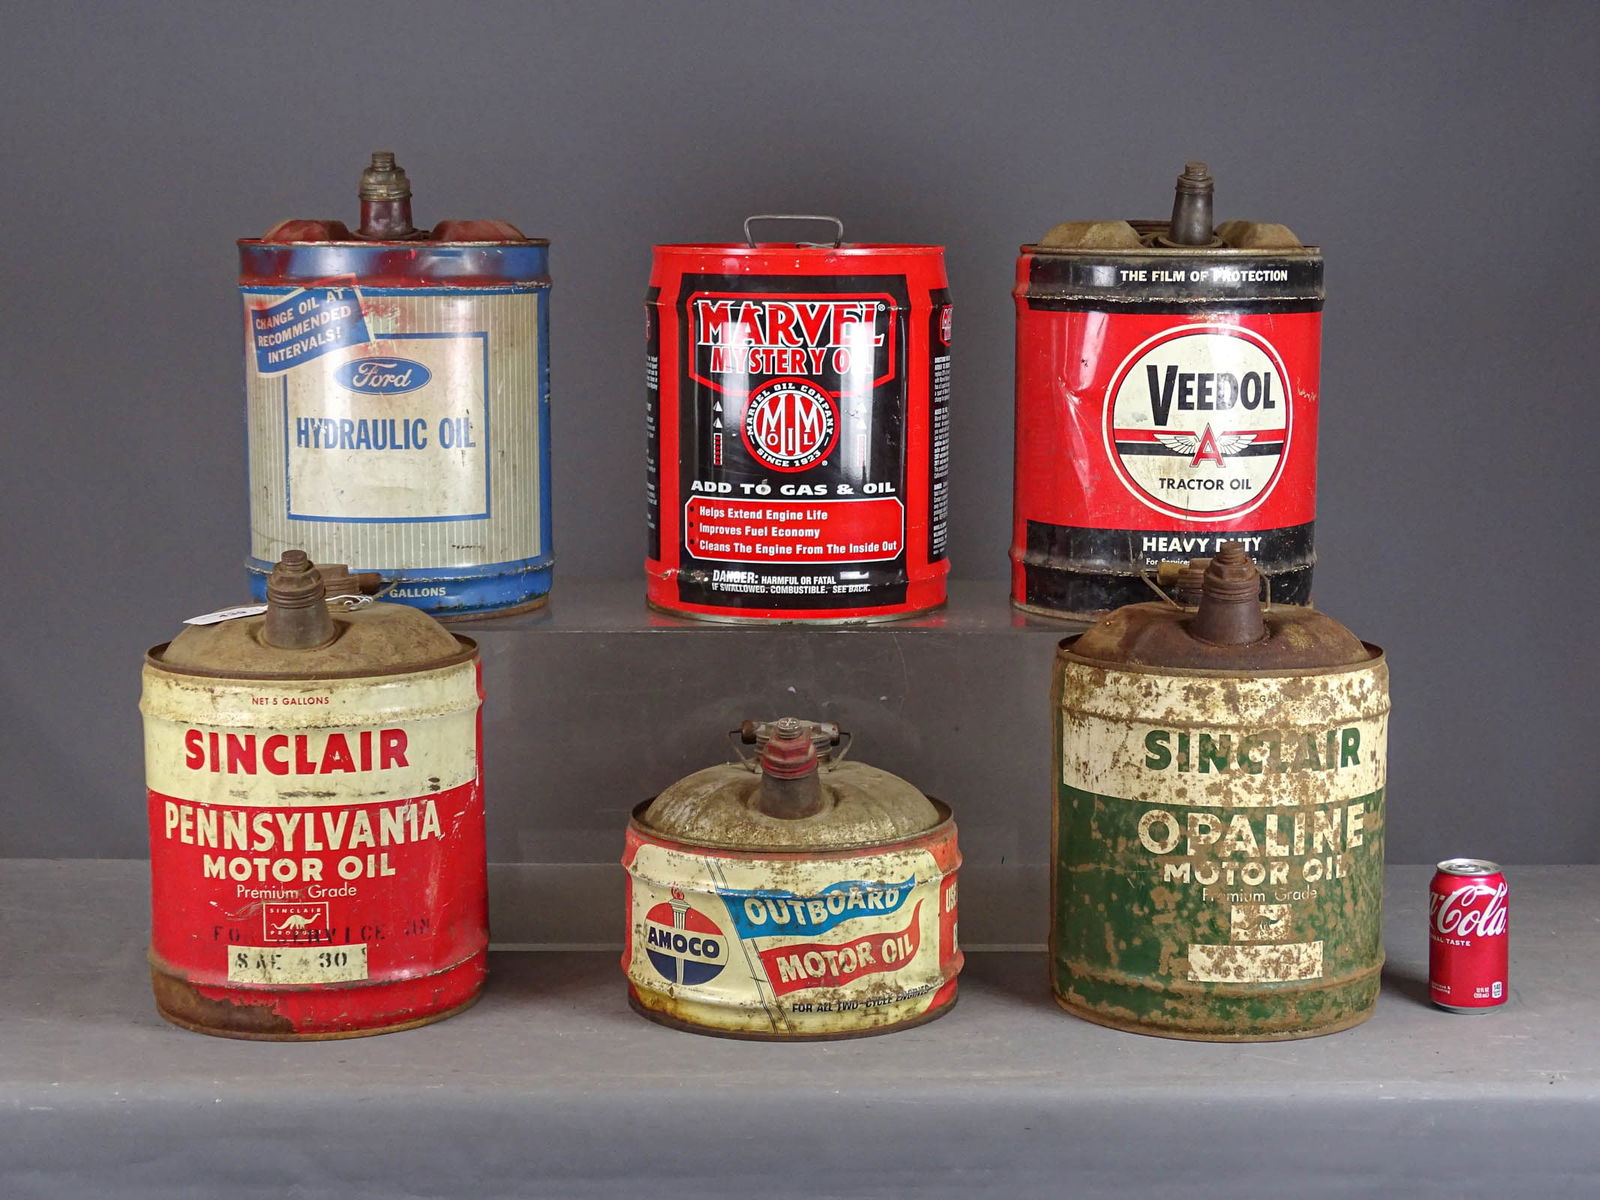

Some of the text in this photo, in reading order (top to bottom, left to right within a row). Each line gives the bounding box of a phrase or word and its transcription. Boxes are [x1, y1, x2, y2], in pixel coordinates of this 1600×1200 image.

[1120, 269, 1288, 282] THE FILM OF PROTECTION
[255, 288, 345, 330] CHANGE OIL AT
[258, 305, 352, 347] RECOMMENDED
[697, 299, 886, 347] MARVEL
[268, 326, 342, 364] INTERVALS!
[710, 346, 828, 375] MYSTERY
[352, 361, 413, 388] Ford
[1146, 364, 1275, 426] VEEDOL
[746, 382, 834, 436] MARVEL OIL COMPANY
[296, 416, 476, 450] HYDRAULIC OIL
[756, 447, 822, 467] SINCE 1923
[690, 480, 896, 496] ADD TO GAS & OIL
[1159, 477, 1252, 491] TRACTOR OIL
[699, 506, 829, 522] Helps Extend Engine Life
[699, 523, 821, 539] Improves Fuel Economy
[699, 539, 897, 556] Cleans The Engine From The Inside Out
[1142, 536, 1262, 553] HEAVY DTY
[1145, 557, 1159, 566] For
[712, 569, 837, 585] DANGER: HARMFUL OR FATAL
[712, 582, 871, 594] IF SWALLOWED. COMBUSTIBLE. SEE BACK.
[389, 586, 447, 599] GALLONS
[252, 696, 330, 706] NET 5 GALLONS
[184, 728, 410, 776] SINCLAIR
[1144, 727, 1361, 775] SINCLAIR
[164, 800, 443, 852] PENNSYLVANIA
[1137, 802, 1365, 858] OPALINE
[203, 853, 396, 882] MOTOR OIL
[1163, 854, 1348, 886] MOTOR OIL
[236, 881, 357, 899] Premium Grade
[1274, 884, 1318, 901] Grade
[743, 886, 899, 926] OUTBOARD
[648, 927, 720, 959] AMOCO
[1445, 938, 1471, 947] TASTE
[236, 952, 348, 970] SAE 30
[779, 942, 877, 984] MOTOR
[882, 934, 914, 964] OIL
[792, 1003, 813, 1013] FOR
[816, 1002, 833, 1013] ALL
